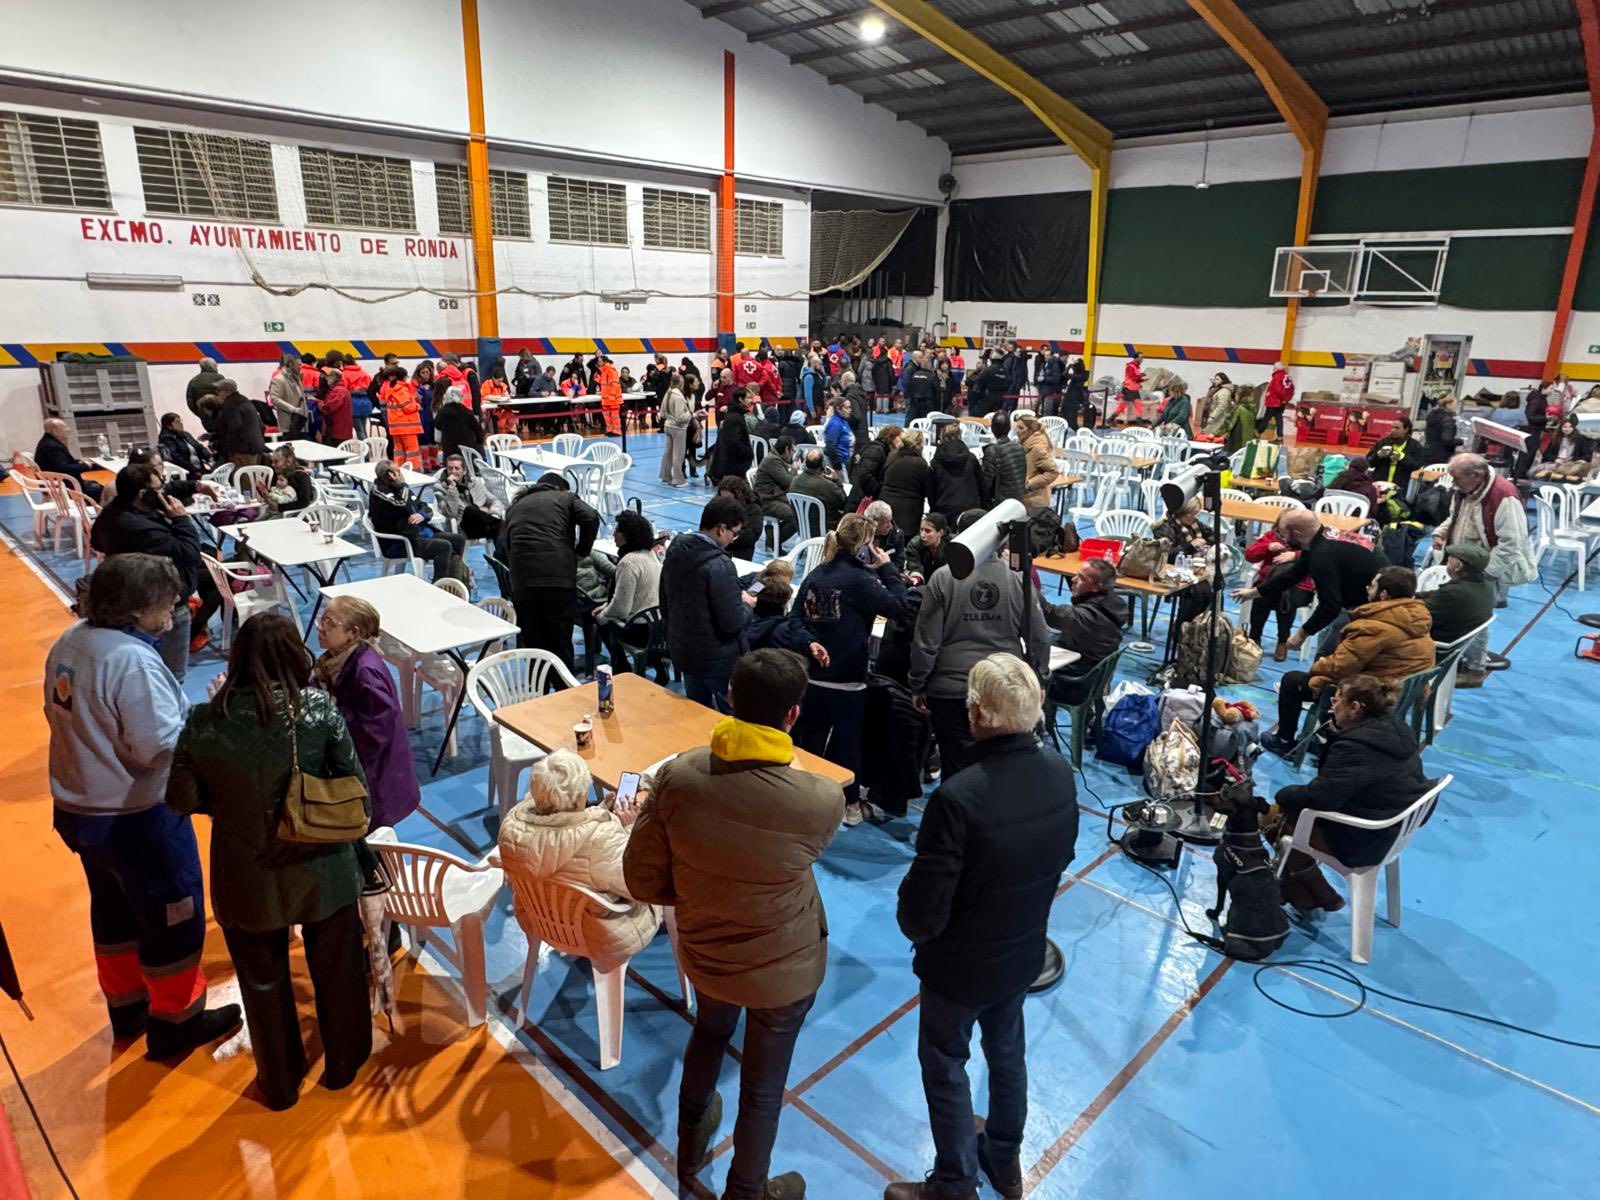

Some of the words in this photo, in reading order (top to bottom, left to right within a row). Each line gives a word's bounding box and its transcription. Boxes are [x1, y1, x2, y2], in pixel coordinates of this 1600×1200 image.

[80, 217, 173, 244] EXCMO.
[190, 224, 342, 253] AYUNTAMIENTO
[360, 237, 389, 256] DE
[404, 237, 459, 259] RONDA
[963, 612, 1002, 622] ZULEMA
